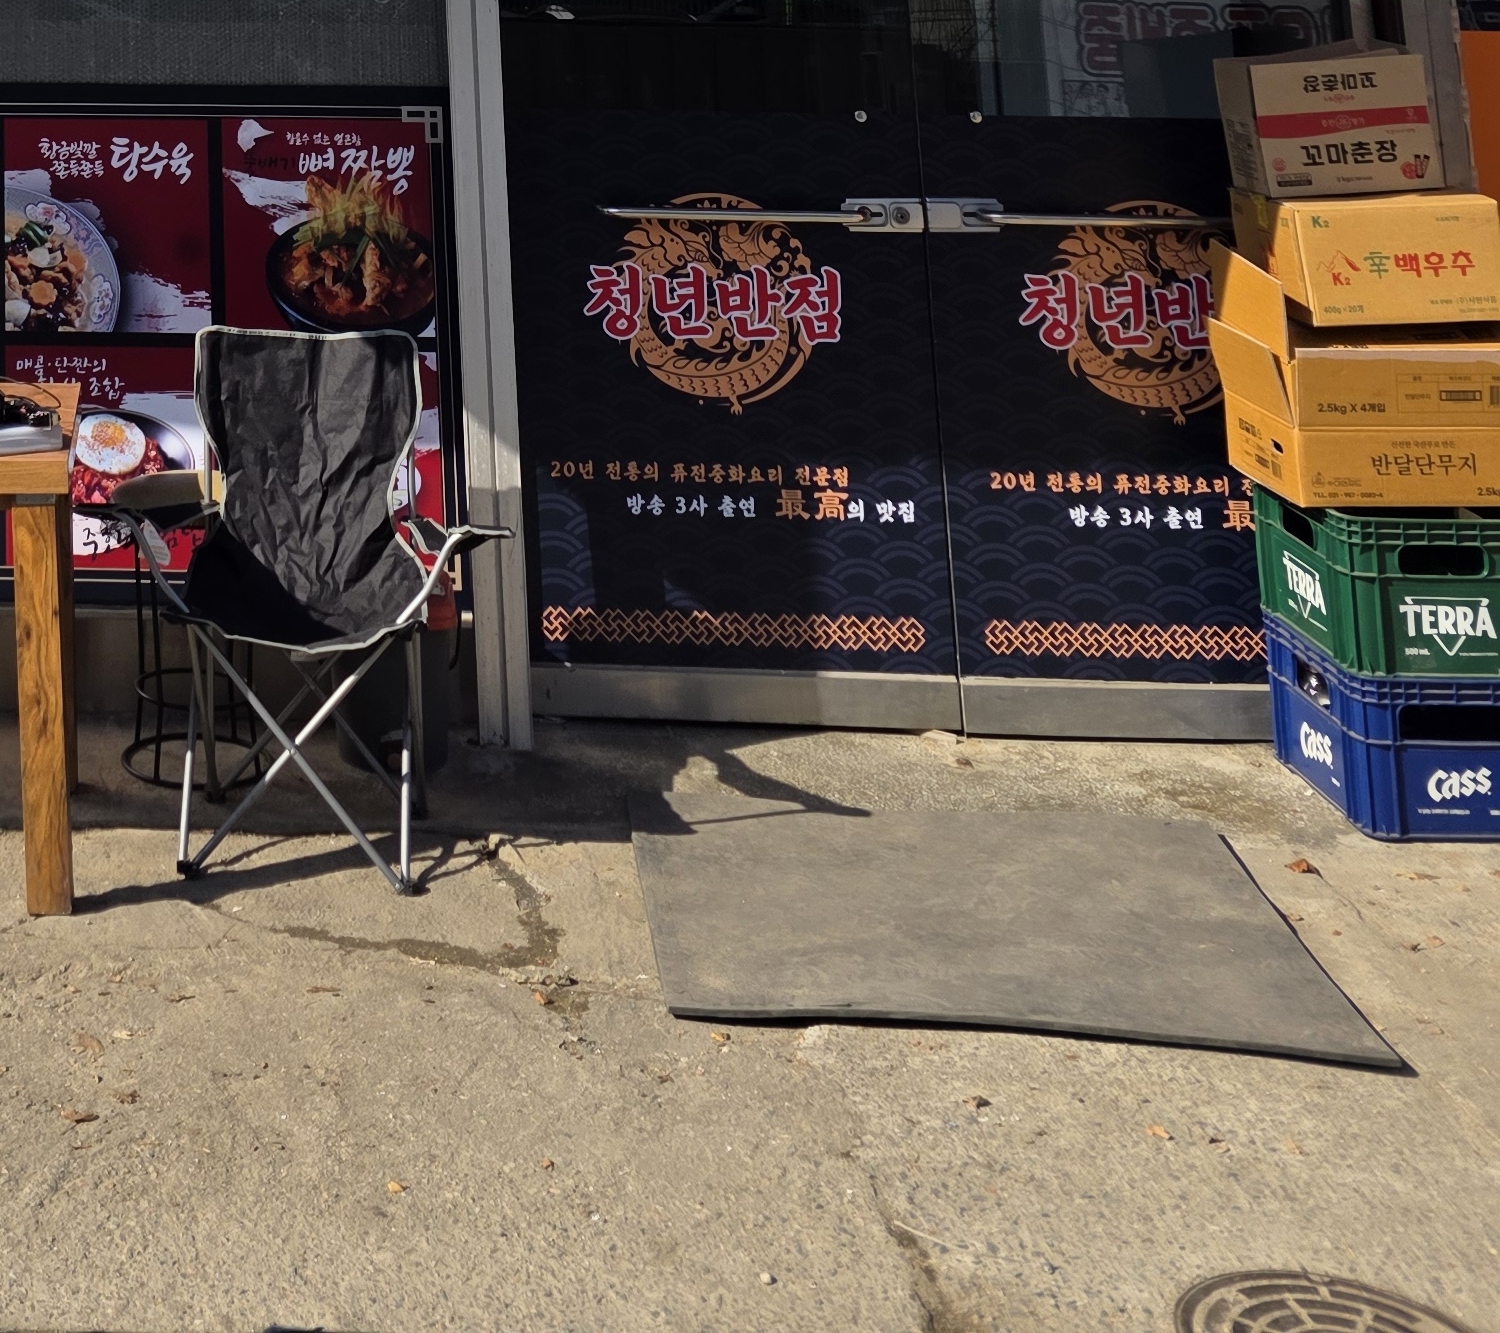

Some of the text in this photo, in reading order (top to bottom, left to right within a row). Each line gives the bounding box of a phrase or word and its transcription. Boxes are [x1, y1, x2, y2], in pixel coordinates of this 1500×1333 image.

[1302, 71, 1379, 94] 꼬마춘장
[37, 137, 102, 161] 황금빛깔
[109, 136, 195, 185] 탕수육
[1299, 139, 1399, 167] 꼬마춘장
[49, 158, 104, 180] 쫀득쫀득
[583, 262, 842, 345] 청년반점
[88, 376, 126, 400] 조합
[1317, 402, 1387, 415] 2.5kg X 4개입
[550, 460, 850, 489] 20년 전통의 퓨전중화요리 전문점
[1370, 452, 1478, 477] 반달단무지
[988, 471, 1037, 493] 20년
[1046, 472, 1103, 495] 전통의
[1113, 473, 1231, 498] 퓨전중화요리
[626, 493, 664, 516] 방송
[675, 495, 707, 519] 3사
[717, 495, 756, 520] 출연
[876, 499, 916, 524] 맛집
[1068, 504, 1110, 529] 방송
[1120, 507, 1154, 530] 3사
[1162, 506, 1204, 531] 출연
[1281, 556, 1328, 616] TERRA
[1398, 603, 1498, 640] TERRA
